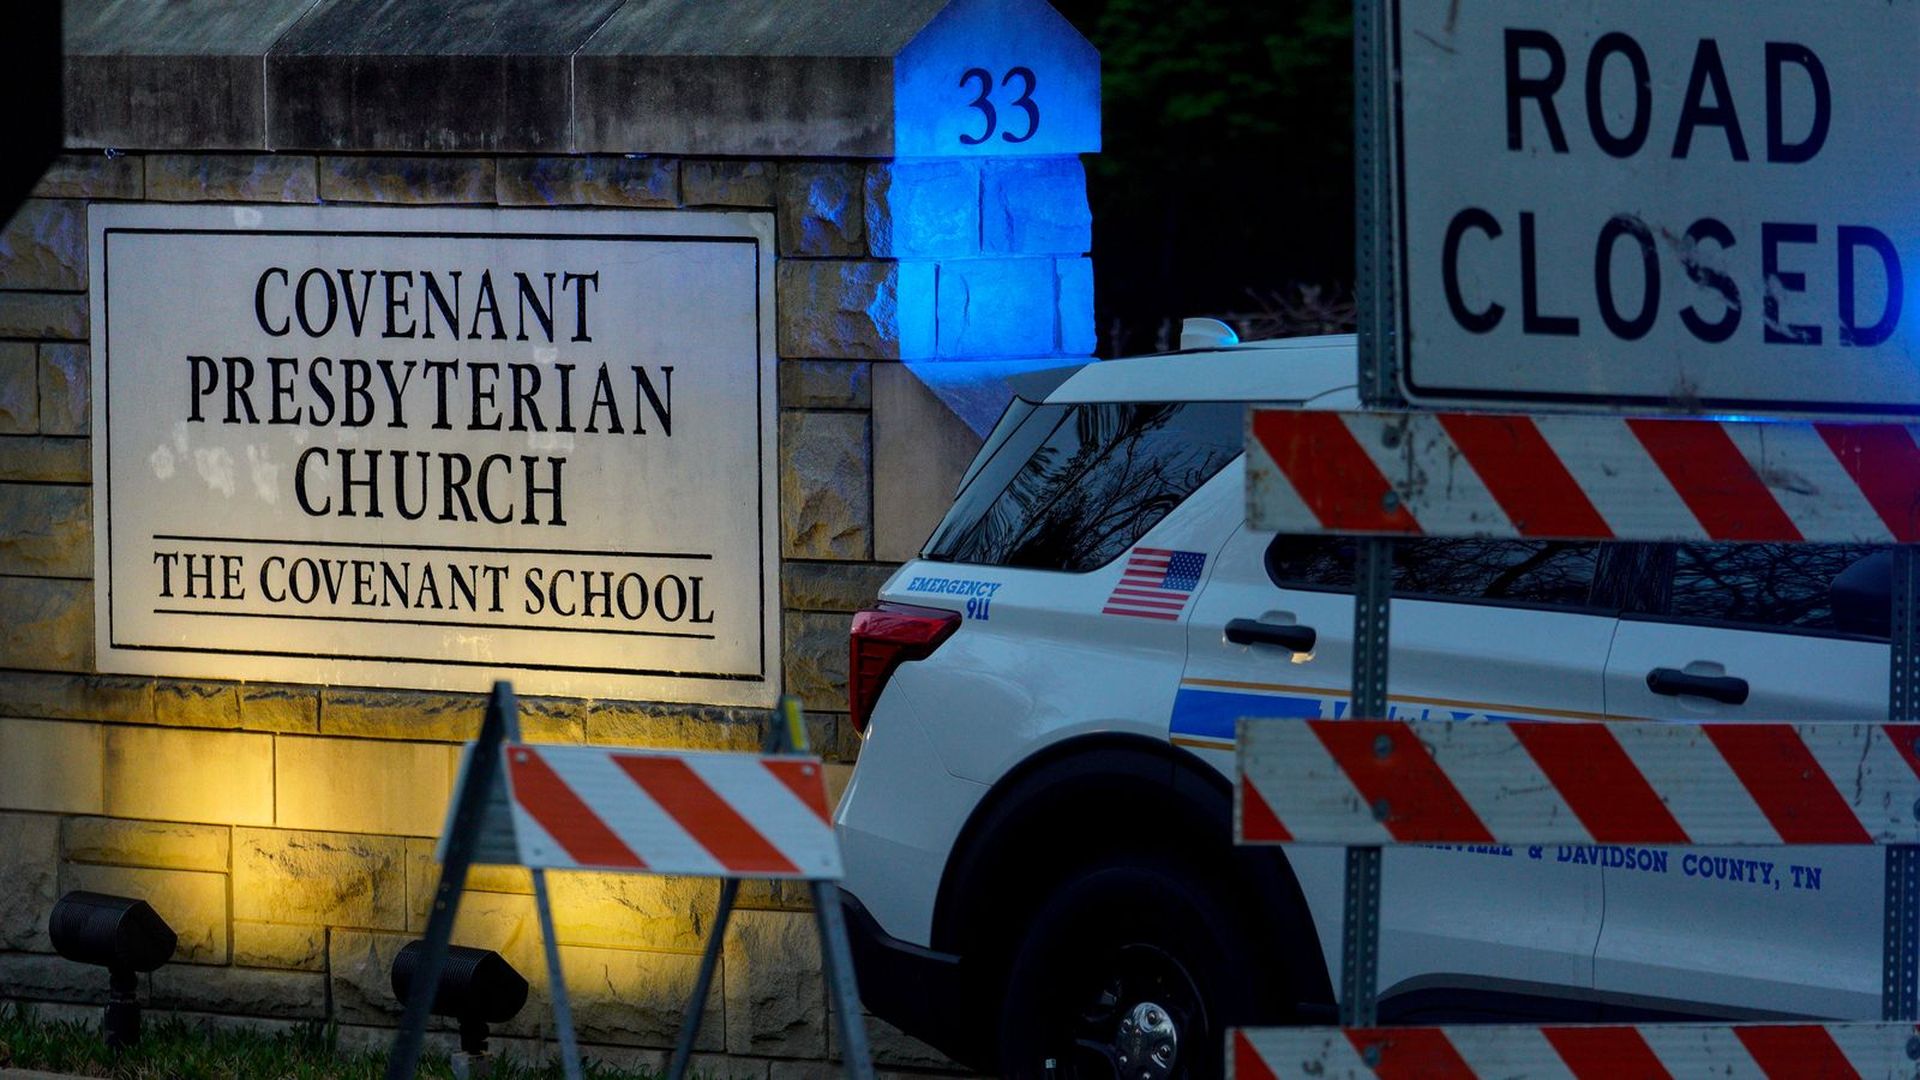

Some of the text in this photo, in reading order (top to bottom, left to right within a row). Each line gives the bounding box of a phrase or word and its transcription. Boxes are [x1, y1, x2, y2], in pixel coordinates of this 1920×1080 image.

[959, 66, 1040, 145] 33
[1504, 28, 1832, 164] ROAD
[253, 266, 600, 343] COVENANT
[1441, 207, 1904, 348] CLOSED
[186, 354, 674, 438] PRESBYTERIAN
[294, 446, 568, 527] CHURCH
[153, 551, 715, 625] THE COVENANT SCHOOL
[907, 577, 1002, 597] EMERGENCY
[966, 597, 991, 620] 911
[1556, 845, 1668, 873] DAVIDSON
[1682, 853, 1780, 891] COUNTY,
[1790, 865, 1822, 891] TN
